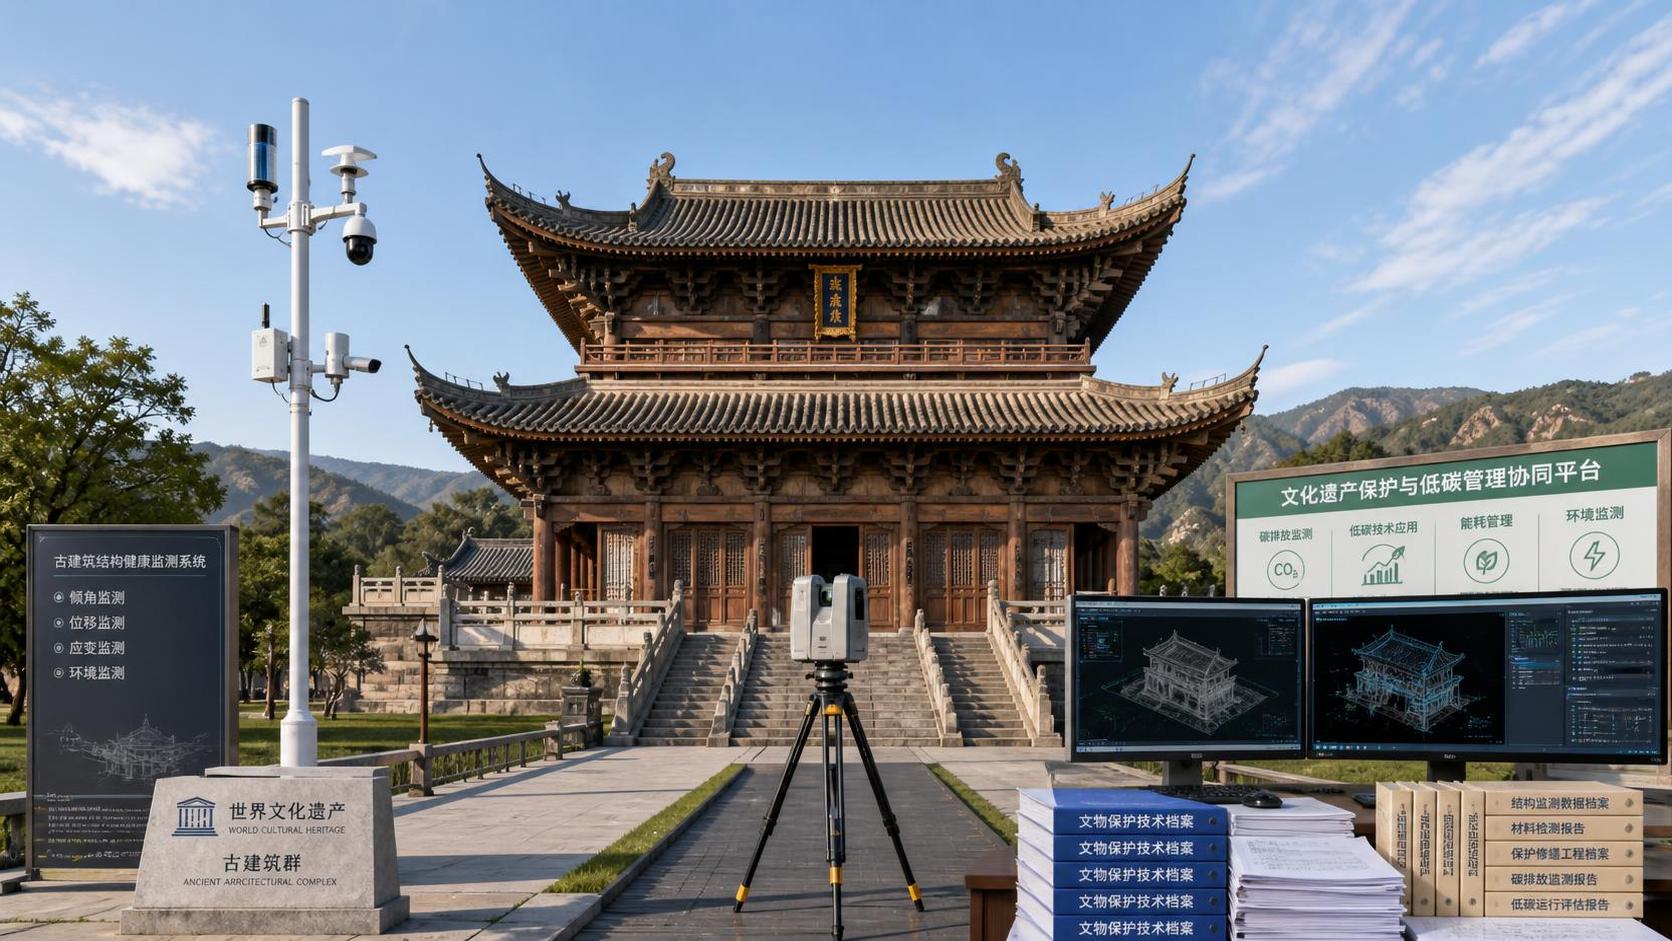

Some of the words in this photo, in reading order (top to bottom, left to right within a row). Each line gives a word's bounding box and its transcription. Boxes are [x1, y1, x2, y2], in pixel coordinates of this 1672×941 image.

[1281, 458, 1601, 507] 文化遗产保护与低碳管理协同平台
[1566, 505, 1624, 523] 环境监测
[1350, 521, 1418, 537] 低碳技术应用
[1460, 514, 1513, 530] 能耗管理
[1259, 528, 1313, 542] 碳排放监测
[53, 554, 207, 569] 古建筑结构健康监测系统
[69, 590, 125, 605] 倾角监测
[69, 615, 125, 630] 位移监测
[69, 641, 125, 655] 应变监测
[69, 666, 125, 680] 环境监测
[229, 802, 346, 821] 世界文化遗产
[1079, 814, 1194, 829] 文物保护技术档案
[1511, 822, 1585, 835] 材料检测报告
[229, 826, 259, 834] WORLD
[261, 826, 303, 834] CULTURAL
[305, 826, 345, 834] HERITAGE
[1079, 841, 1194, 856] 文物保护技术档案
[223, 853, 302, 873] 古建筑群
[183, 878, 220, 886] ANCIENT
[296, 878, 337, 886] COMPLEX
[1079, 867, 1194, 882] 文物保护技术档案
[1079, 894, 1194, 909] 文物保护技术档案
[1511, 898, 1610, 911] 低碳运行评估报告
[1079, 921, 1194, 936] 文物保护技术档案
